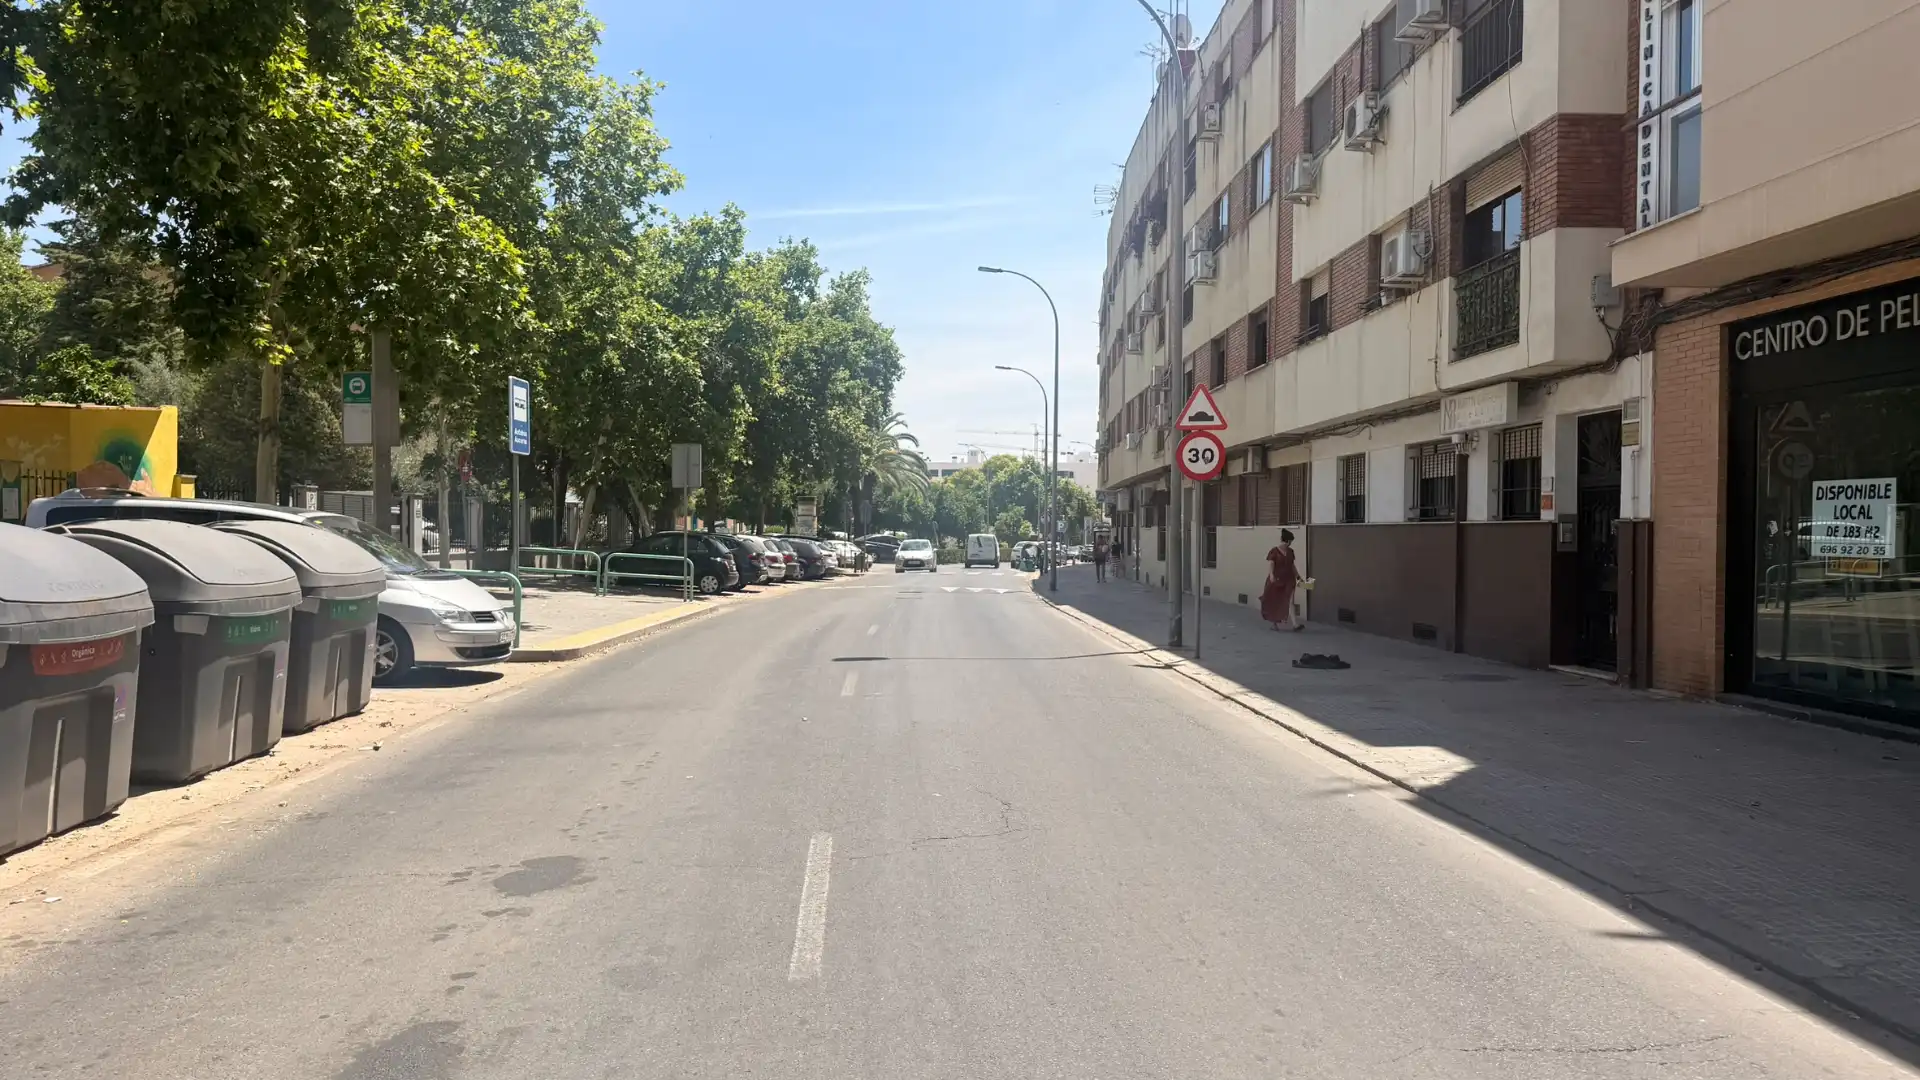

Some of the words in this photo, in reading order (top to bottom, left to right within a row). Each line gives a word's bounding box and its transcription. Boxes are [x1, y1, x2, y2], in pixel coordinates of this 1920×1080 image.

[1641, 125, 1652, 228] DENTAL
[1735, 315, 1829, 361] CENTRO
[1836, 304, 1870, 341] DE
[1188, 448, 1214, 464] 30
[1816, 483, 1892, 501] DISPONIBLE
[1833, 504, 1873, 520] LOCAL
[1826, 526, 1840, 537] DE
[1842, 526, 1861, 538] 183
[1864, 526, 1880, 538] M2
[1820, 545, 1837, 554] 696
[1840, 546, 1853, 555] 92
[1856, 547, 1869, 555] 20
[1872, 547, 1886, 556] 35
